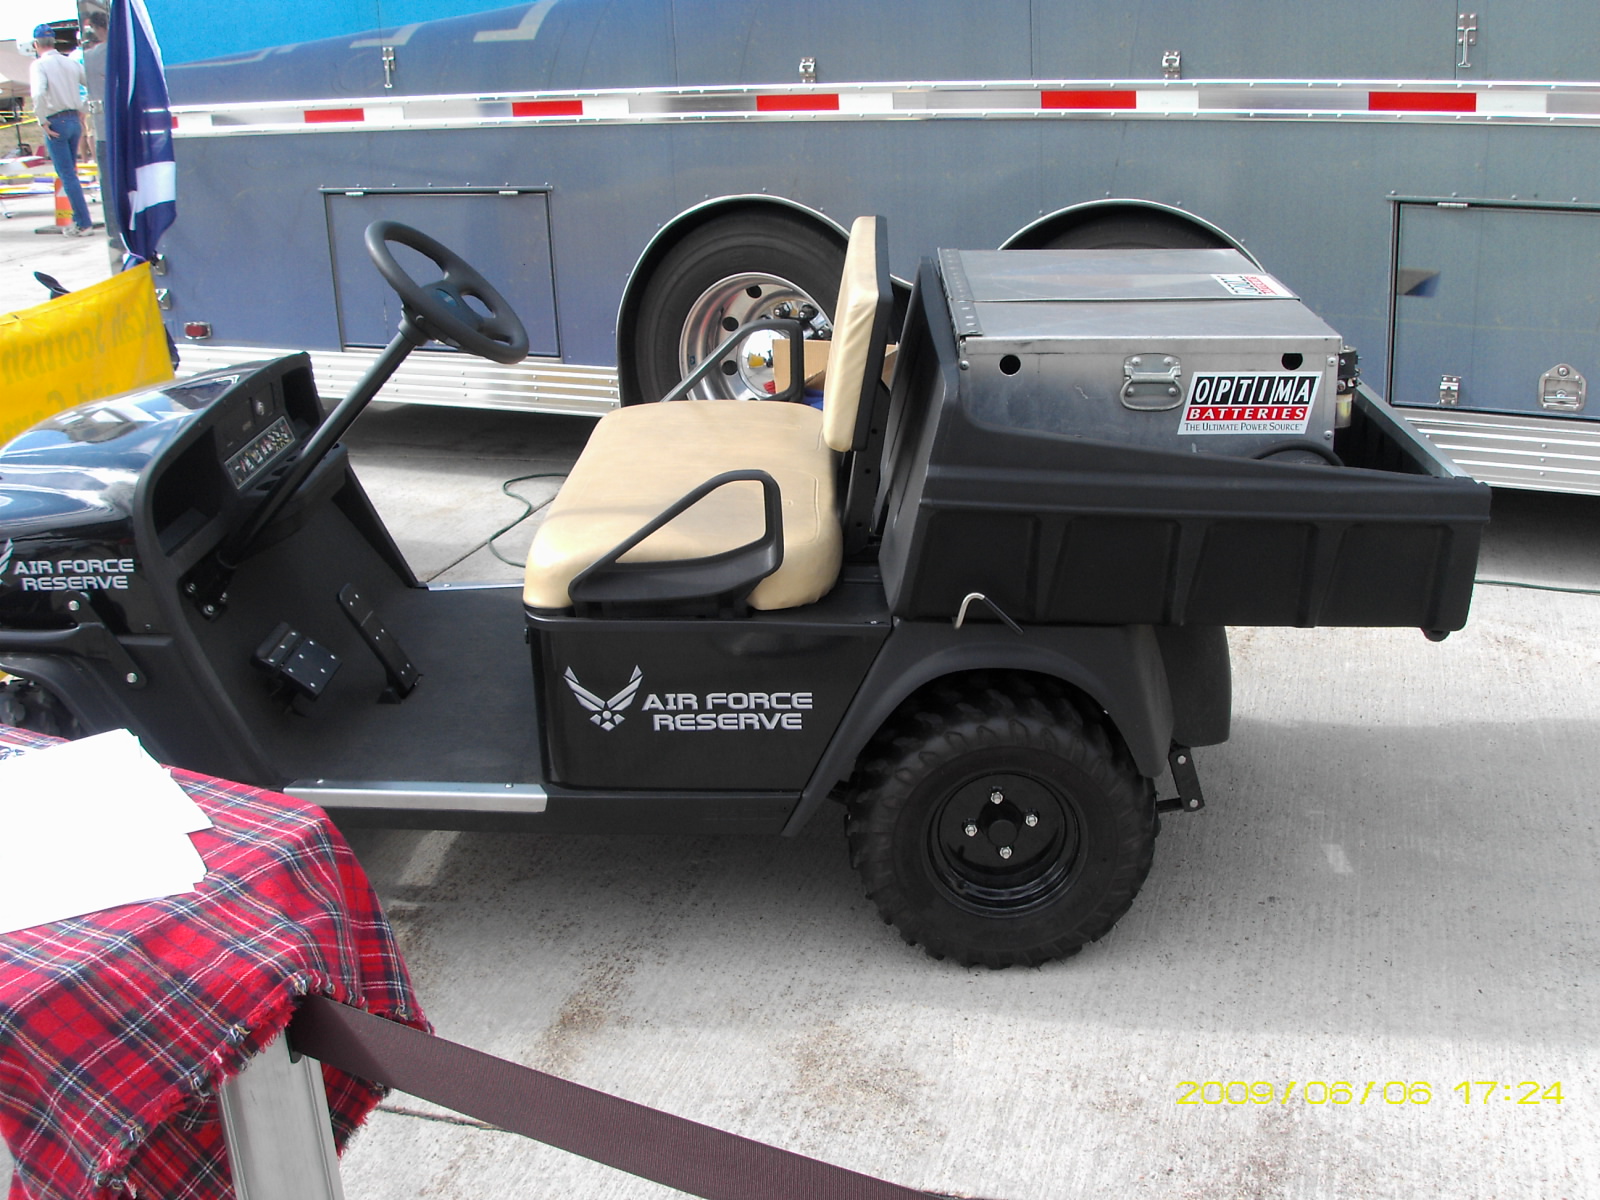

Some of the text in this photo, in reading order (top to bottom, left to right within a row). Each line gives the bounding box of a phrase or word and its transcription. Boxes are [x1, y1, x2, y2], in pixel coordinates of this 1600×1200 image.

[1193, 377, 1312, 404] OPTIMA
[1188, 408, 1305, 420] BATTERIES
[14, 559, 135, 575] AIR FORCE
[22, 575, 129, 591] RESERVE
[641, 692, 813, 712] AIR FORCE
[653, 713, 803, 732] RESERVE
